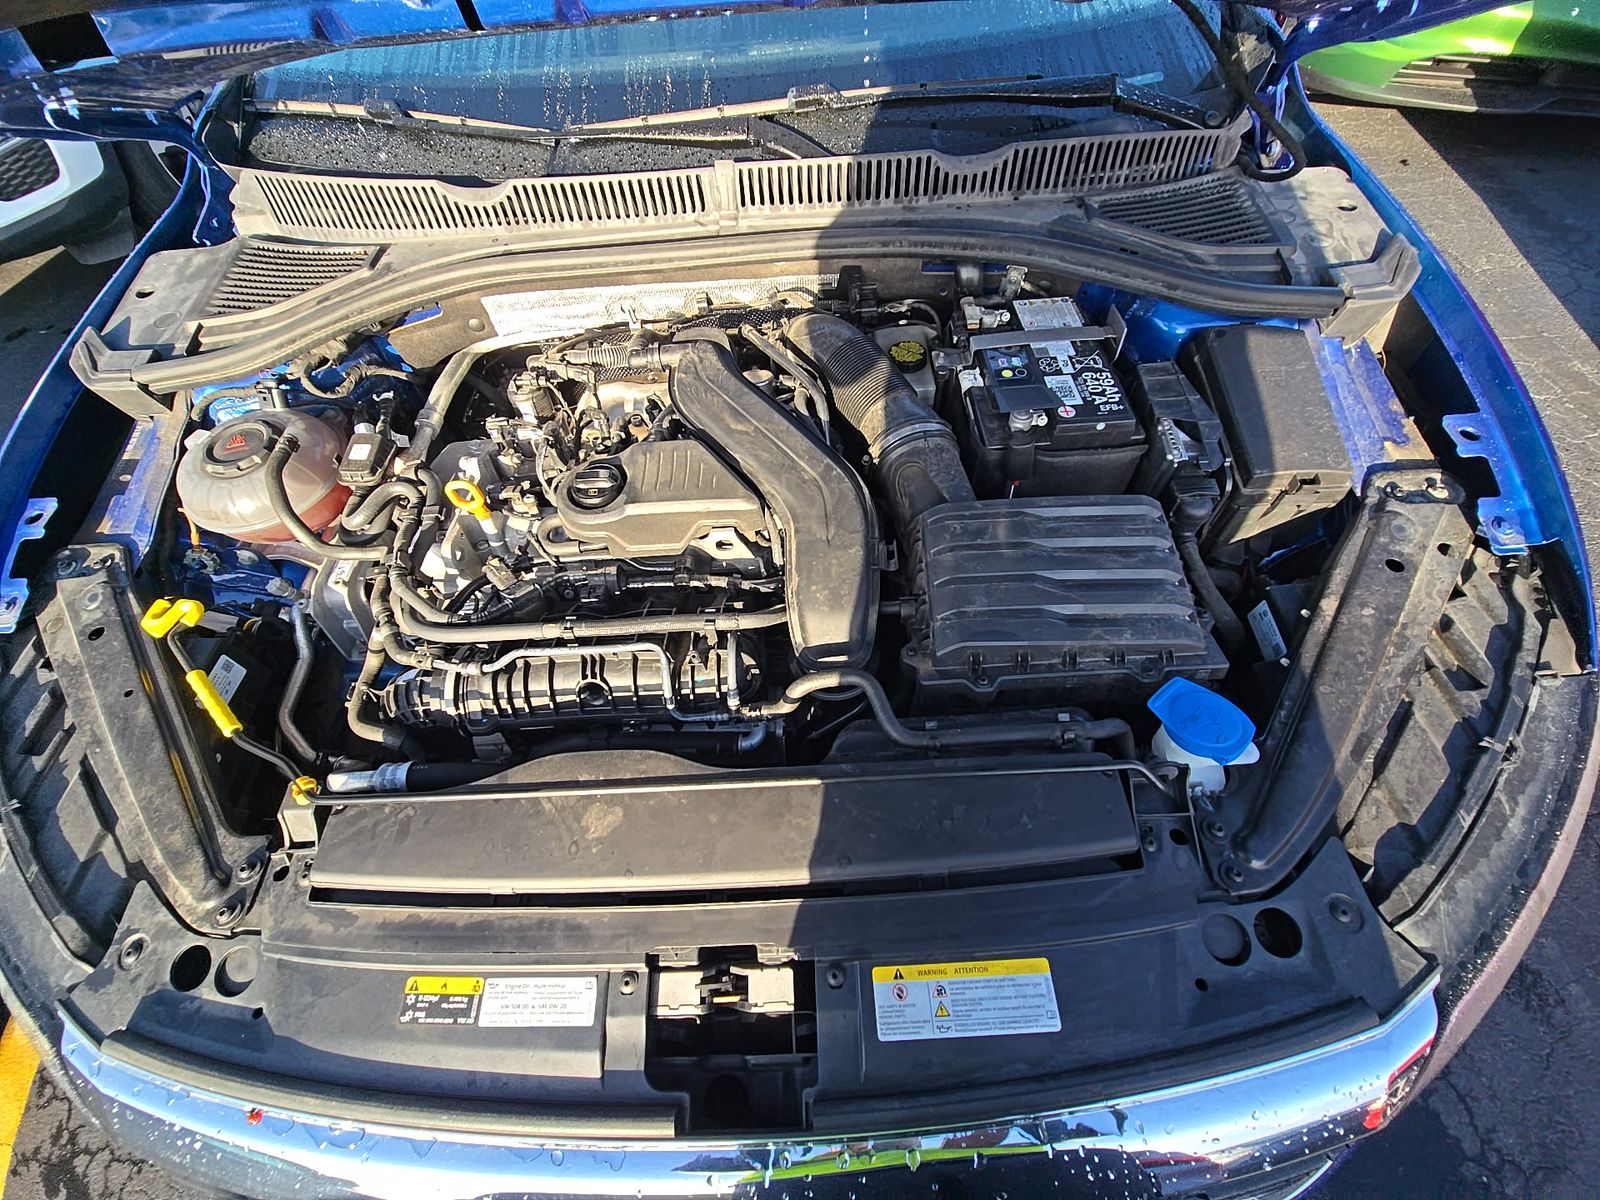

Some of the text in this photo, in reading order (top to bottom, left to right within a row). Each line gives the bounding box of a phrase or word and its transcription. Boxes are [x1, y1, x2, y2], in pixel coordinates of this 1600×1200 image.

[1082, 371, 1102, 394] 640
[1093, 395, 1107, 404] A
[1097, 372, 1121, 403] 59Ah
[916, 966, 989, 977] WARNING ATTENTION
